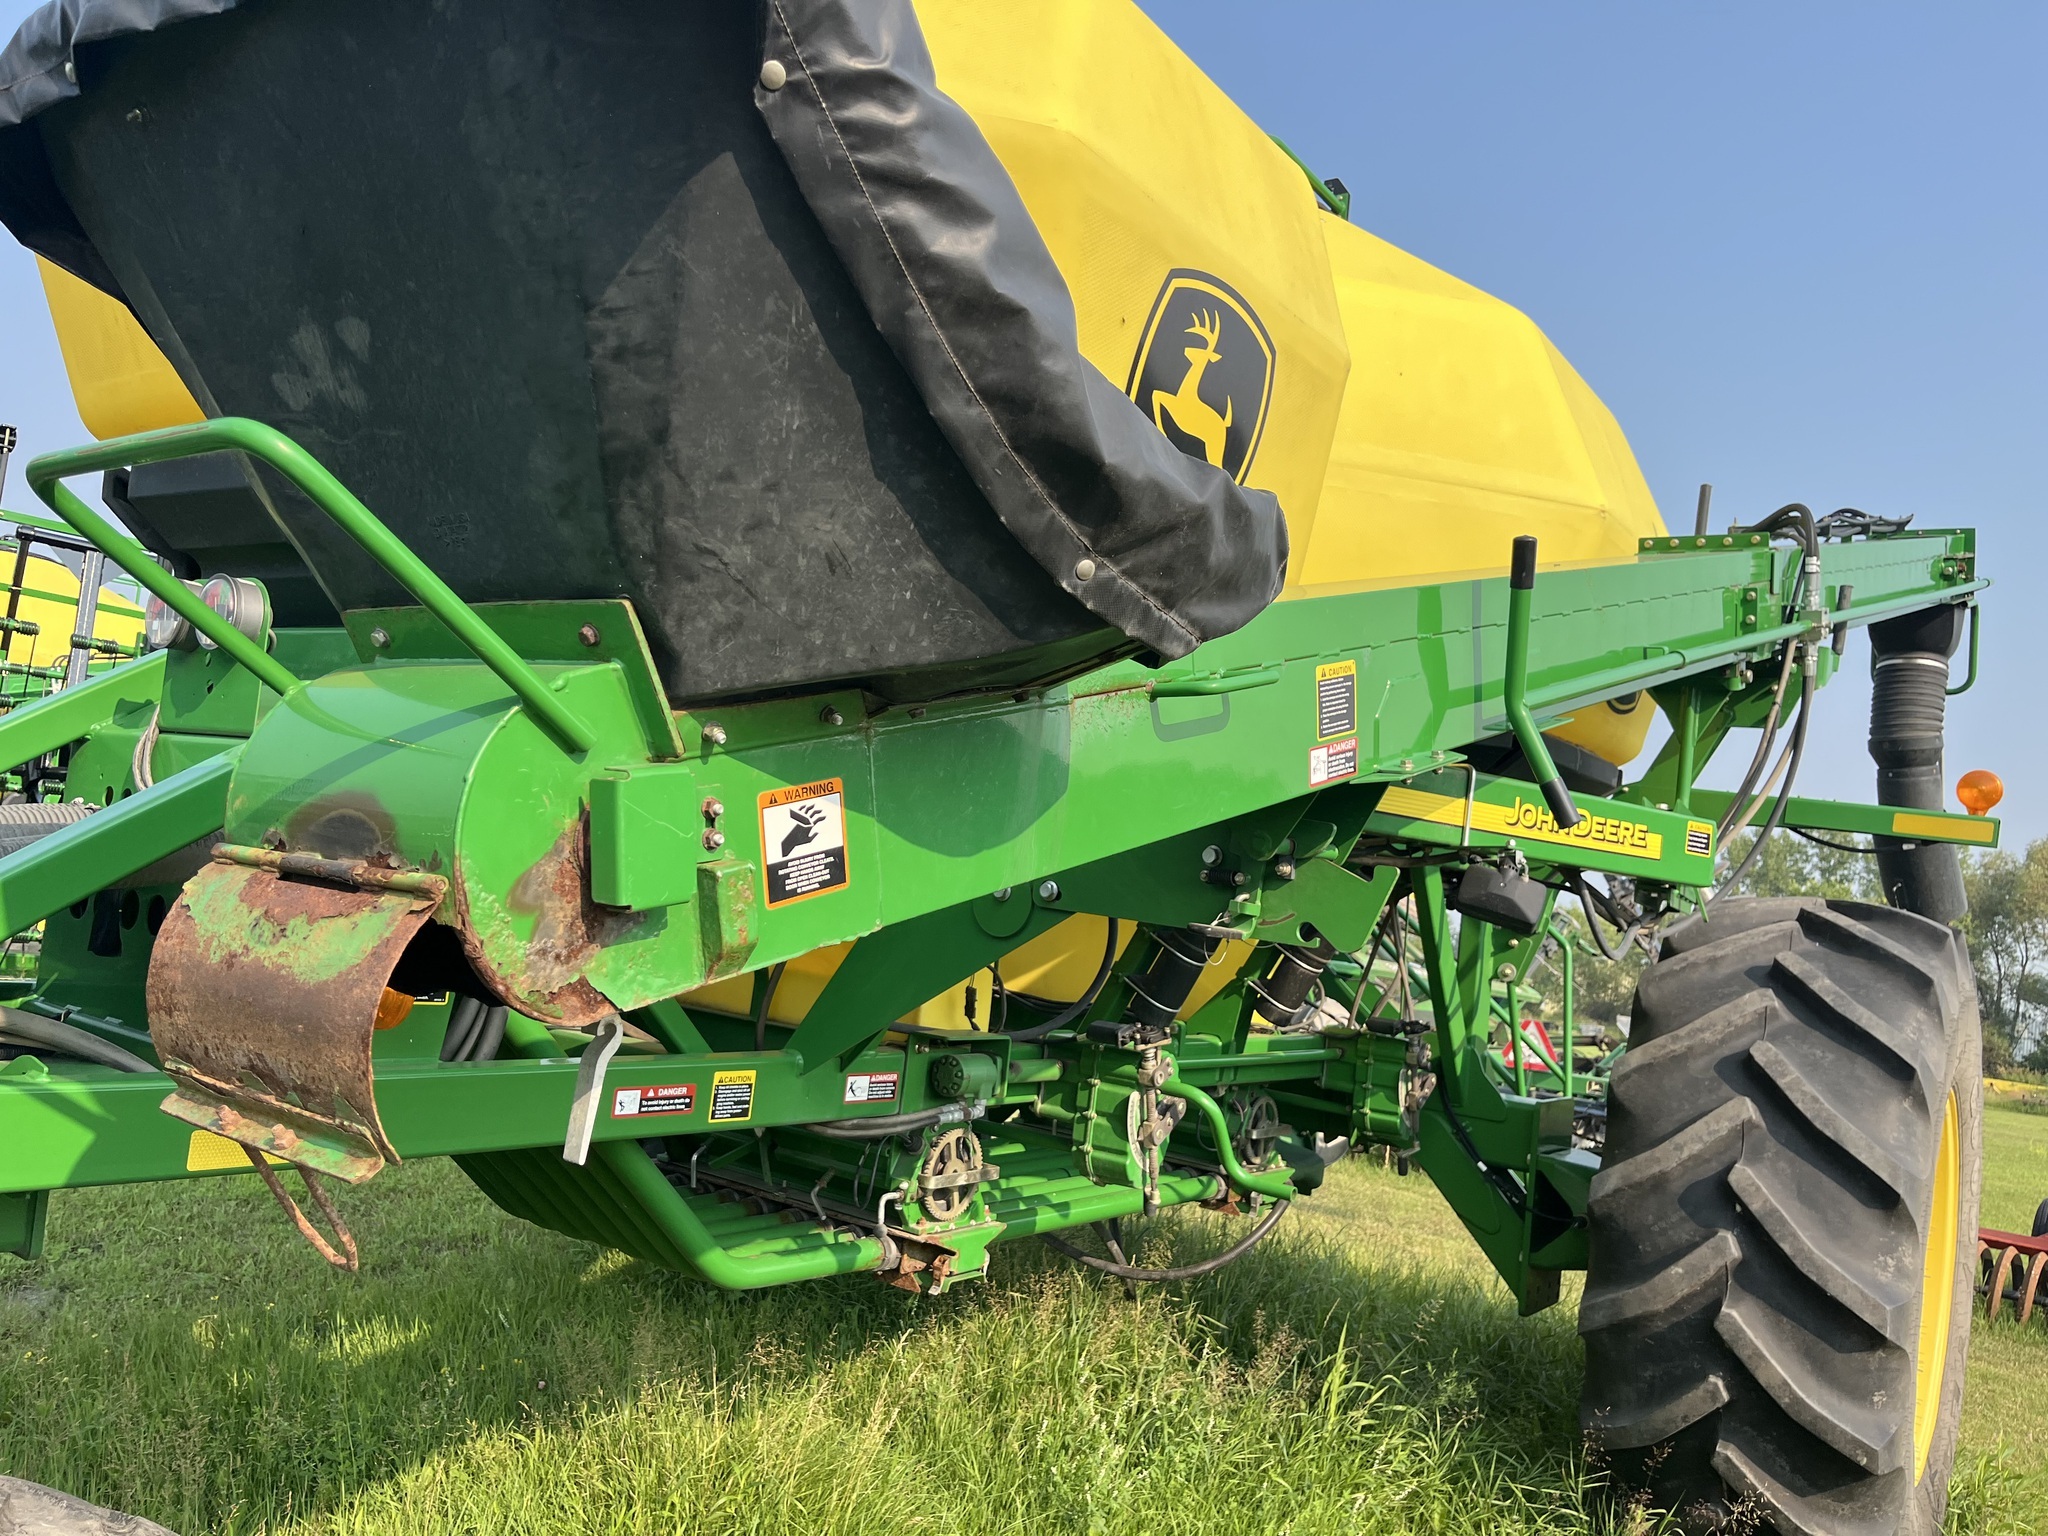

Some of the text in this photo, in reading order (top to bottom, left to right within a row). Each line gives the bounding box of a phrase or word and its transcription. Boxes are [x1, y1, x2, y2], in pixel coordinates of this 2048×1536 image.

[1328, 665, 1352, 677] CAUTION
[1333, 739, 1355, 752] DANGER
[784, 782, 834, 801] WARNING
[1505, 797, 1569, 835] JOH
[1573, 808, 1648, 848] DEERE
[724, 1075, 752, 1083] CAUTION
[658, 1087, 687, 1096] DANGER
